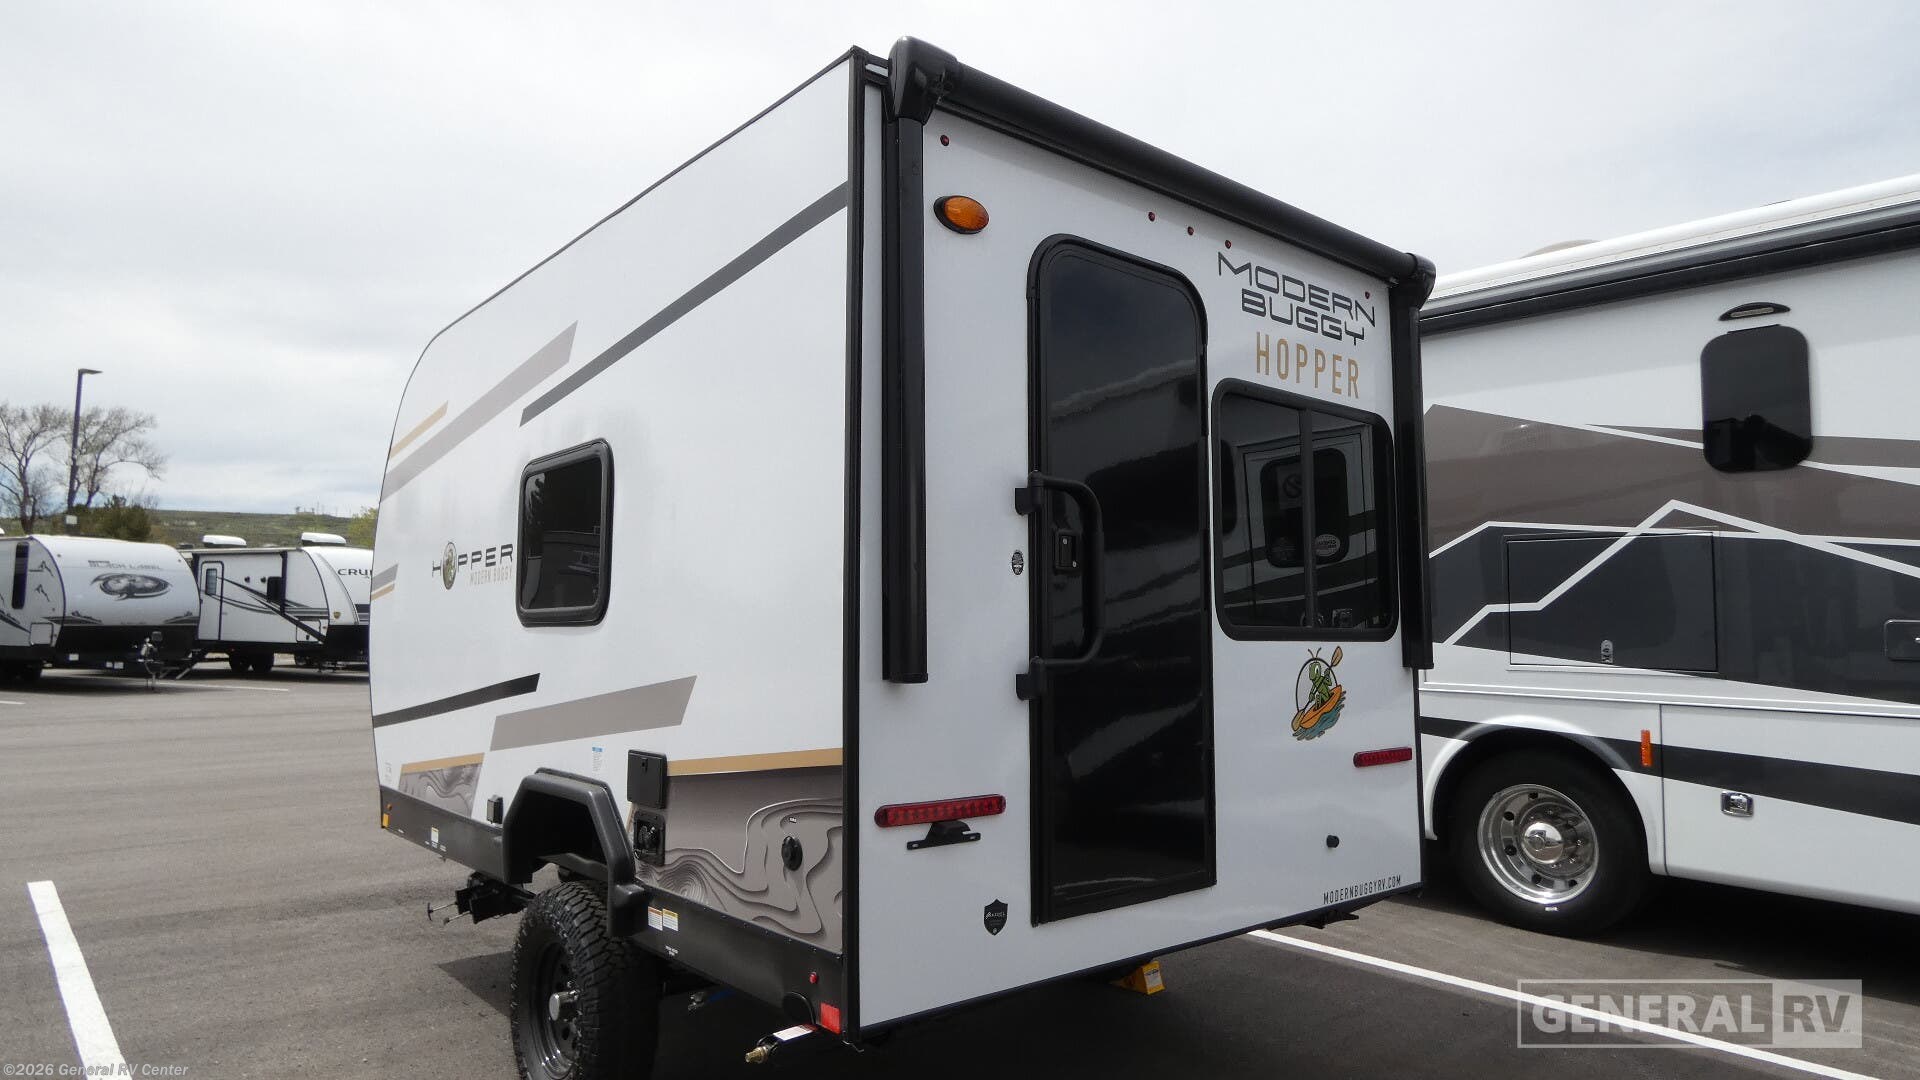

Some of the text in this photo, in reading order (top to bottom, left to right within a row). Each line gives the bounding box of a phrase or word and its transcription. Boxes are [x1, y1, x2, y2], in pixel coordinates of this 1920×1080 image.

[1218, 251, 1376, 328] MODERN
[1241, 288, 1365, 346] BUGGY
[1256, 331, 1360, 399] HOPPER
[1323, 875, 1401, 905] MODERNBUGGYRV.COM
